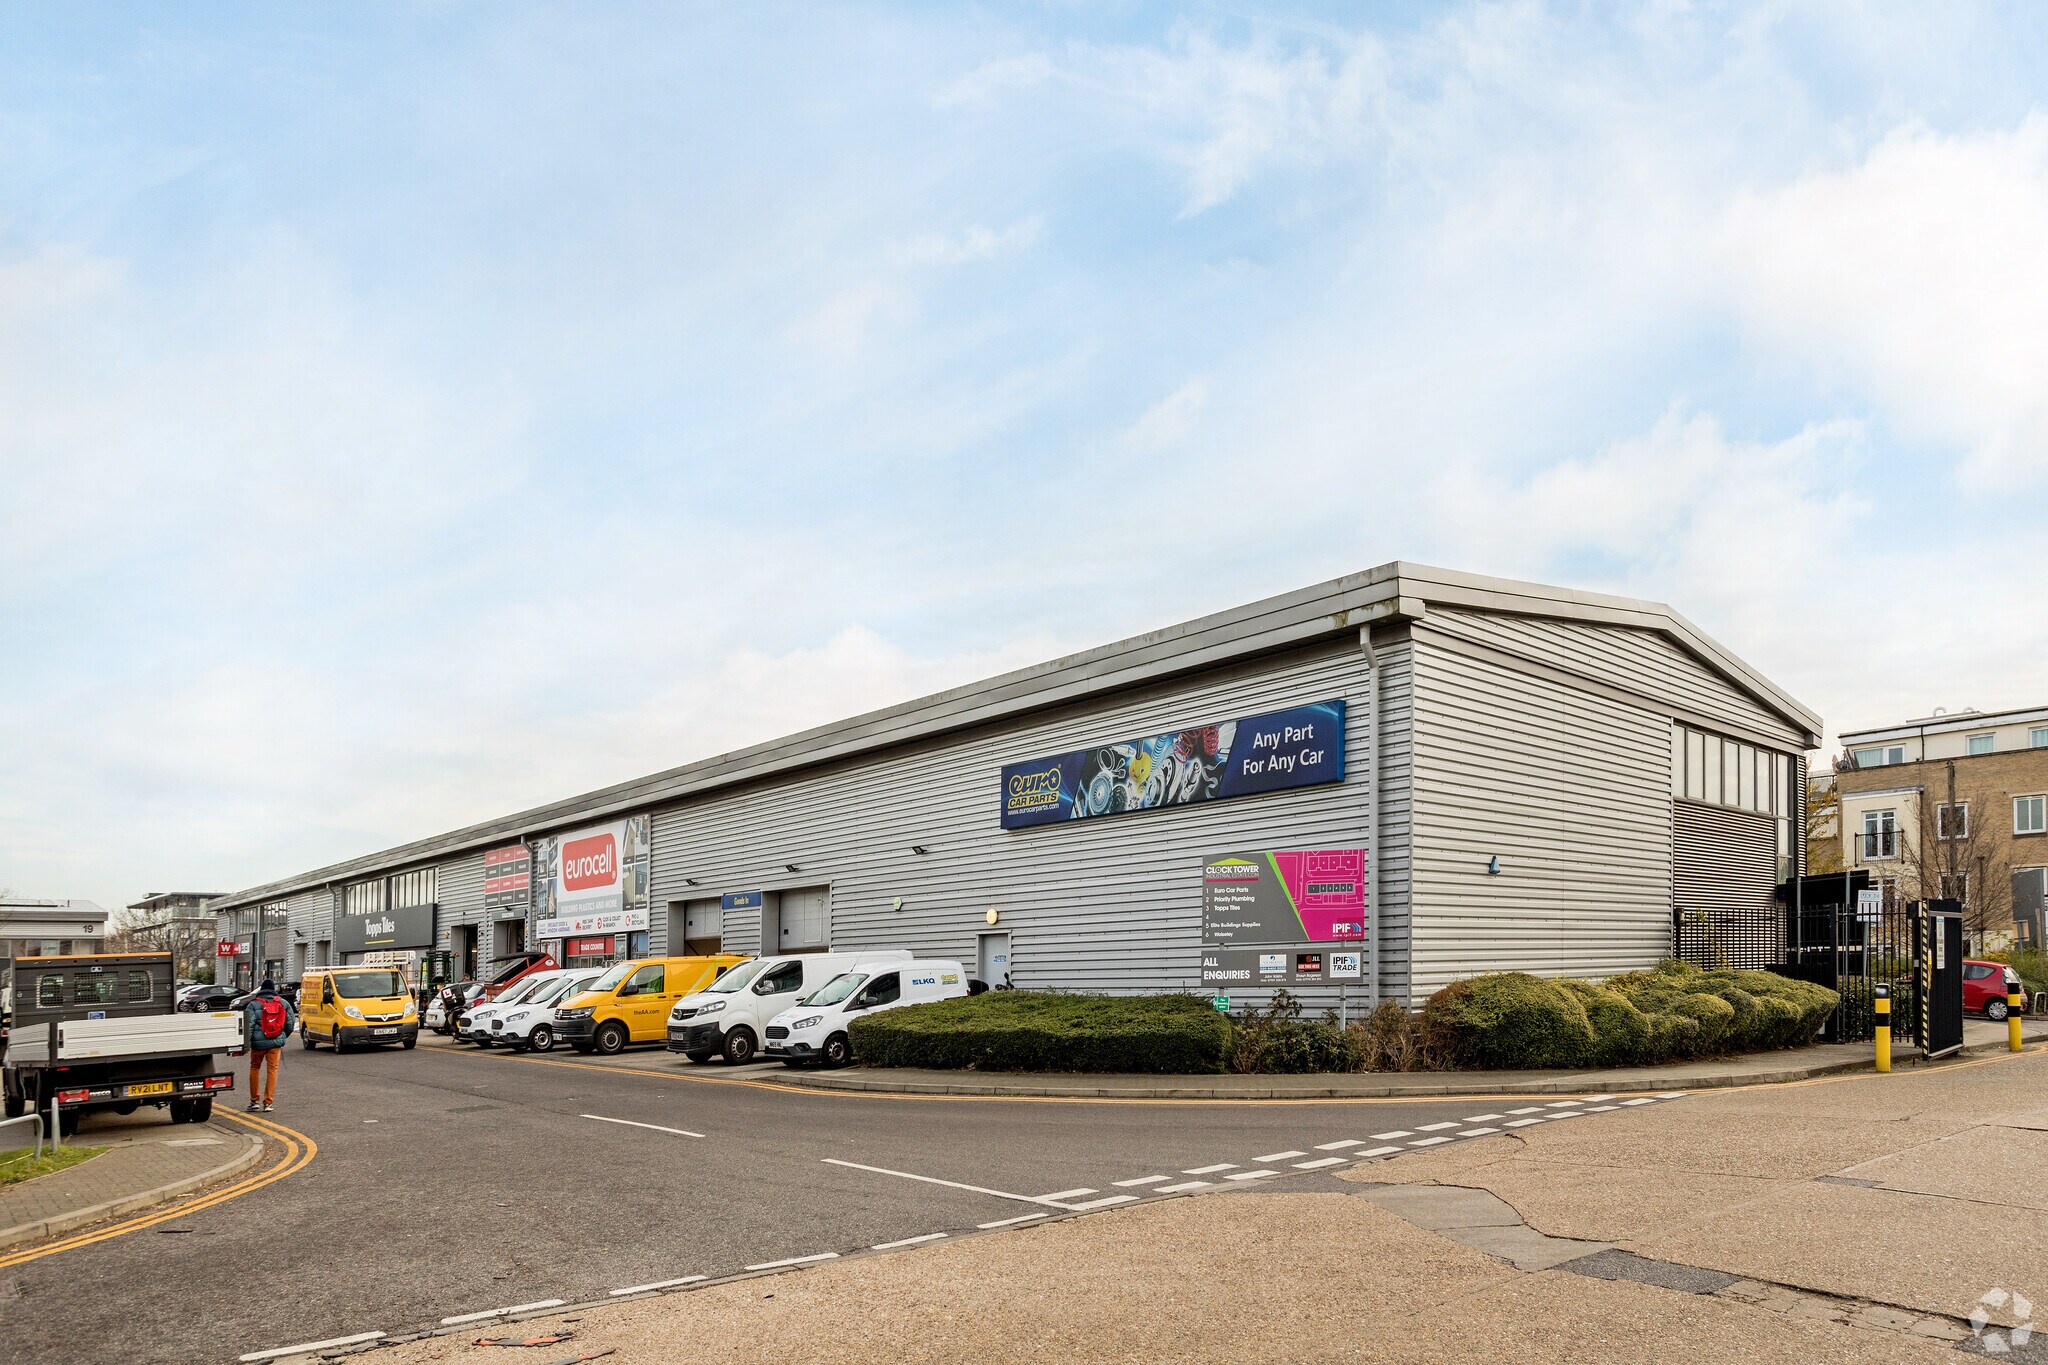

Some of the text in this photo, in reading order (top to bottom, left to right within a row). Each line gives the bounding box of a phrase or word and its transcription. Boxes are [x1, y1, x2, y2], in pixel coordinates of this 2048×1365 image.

[1252, 723, 1314, 750] Any Part
[1243, 748, 1324, 775] For Any Car
[1009, 767, 1061, 797] euro
[1009, 793, 1057, 808] CAR PARTS
[1007, 803, 1060, 816] www.eurocarparts.com
[565, 843, 613, 879] eurocell
[1205, 865, 1259, 874] CLOCK TOWER
[1231, 895, 1255, 903] Plumbing
[560, 898, 617, 914] BUILDING PLASTICS AND MORE
[83, 924, 94, 933] 19
[365, 916, 395, 937] Topps Tiles
[1332, 923, 1351, 933] IPIF
[220, 944, 231, 952] W
[1203, 957, 1219, 967] ALL
[1332, 956, 1349, 965] IPIF
[1332, 964, 1357, 972] TRADE
[1203, 970, 1251, 980] ENQUIRIES
[919, 977, 936, 985] LKQ
[131, 1083, 170, 1095] RV21 LNT
